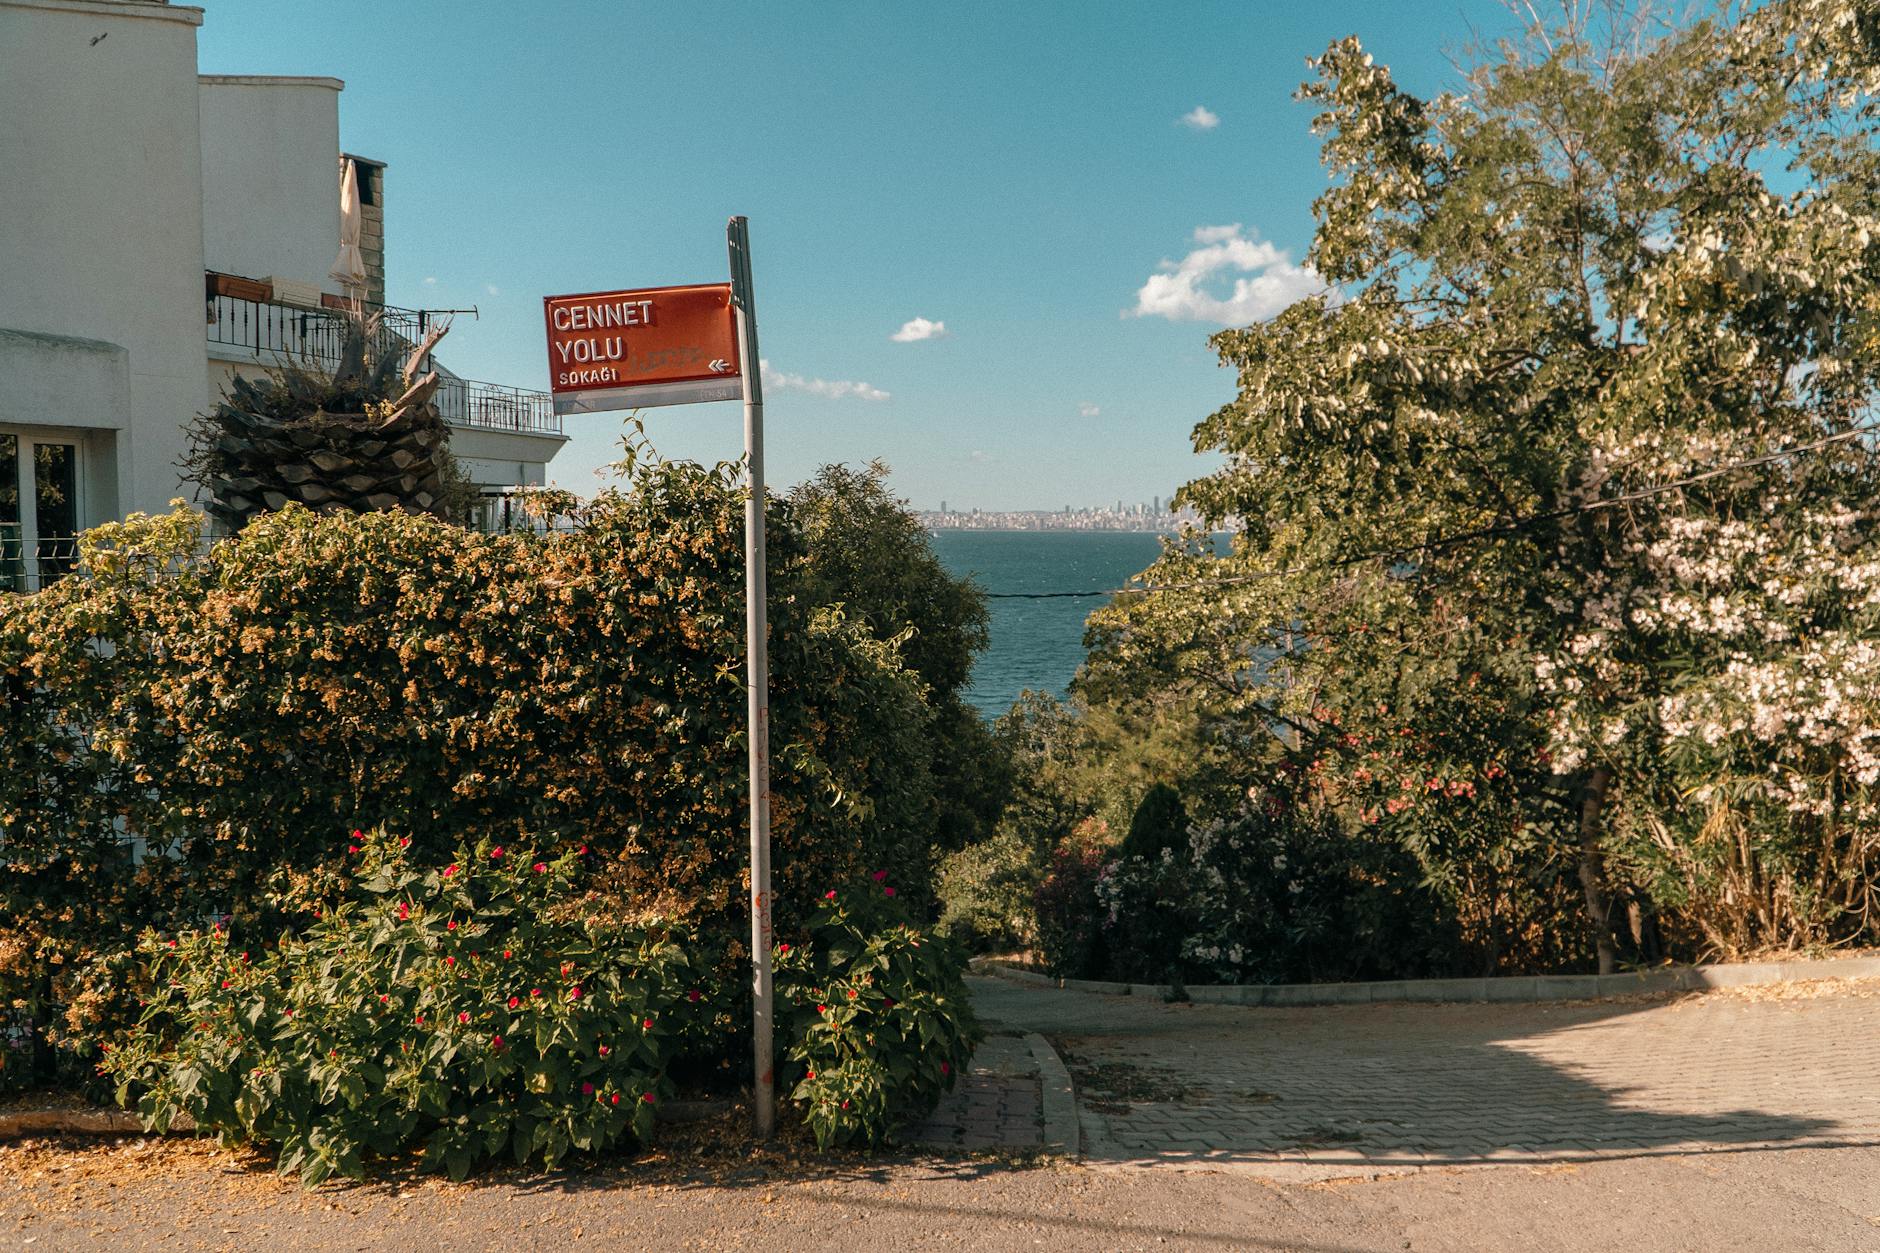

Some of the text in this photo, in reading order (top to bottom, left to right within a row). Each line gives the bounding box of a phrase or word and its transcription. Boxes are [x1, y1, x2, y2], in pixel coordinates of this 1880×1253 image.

[554, 300, 653, 331] CENNET
[555, 337, 623, 364] YOLU
[559, 367, 617, 385] SOKAĞI
